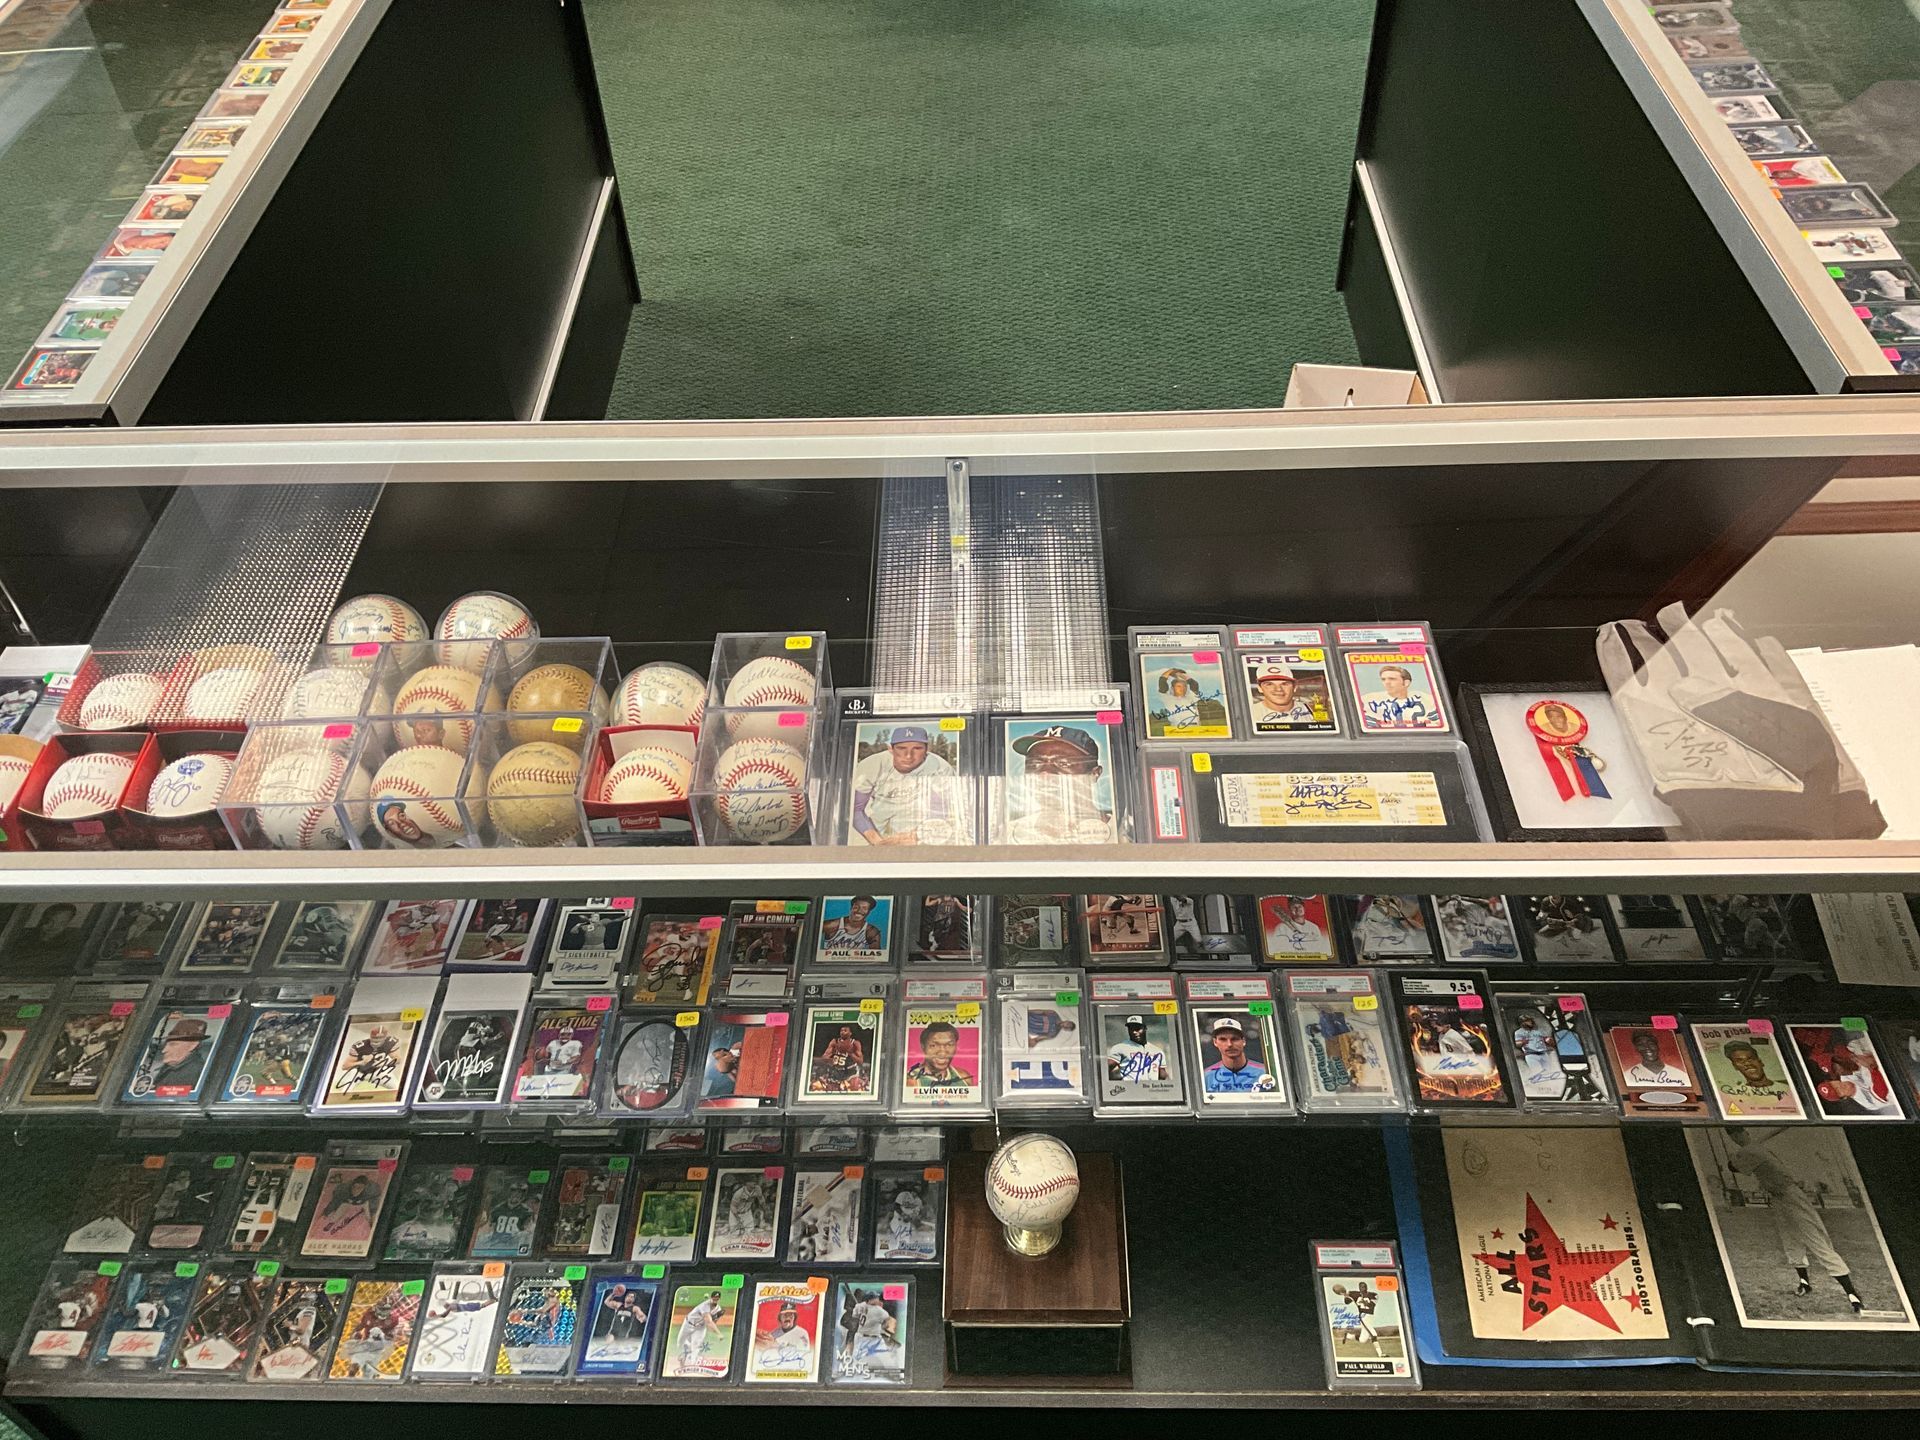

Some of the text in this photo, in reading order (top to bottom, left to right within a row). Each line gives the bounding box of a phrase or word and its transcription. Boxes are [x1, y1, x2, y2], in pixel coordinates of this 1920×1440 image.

[1350, 654, 1425, 663] COWBOYS
[766, 915, 796, 923] COMING
[1450, 983, 1466, 992] 9.5
[539, 1016, 599, 1030] ALL-TIME
[1701, 1029, 1721, 1039] bob
[833, 1055, 847, 1066] 35
[496, 1217, 519, 1232] 88
[1496, 1250, 1523, 1295] ALL
[1518, 1227, 1552, 1316] STARS
[760, 1286, 781, 1296] All
